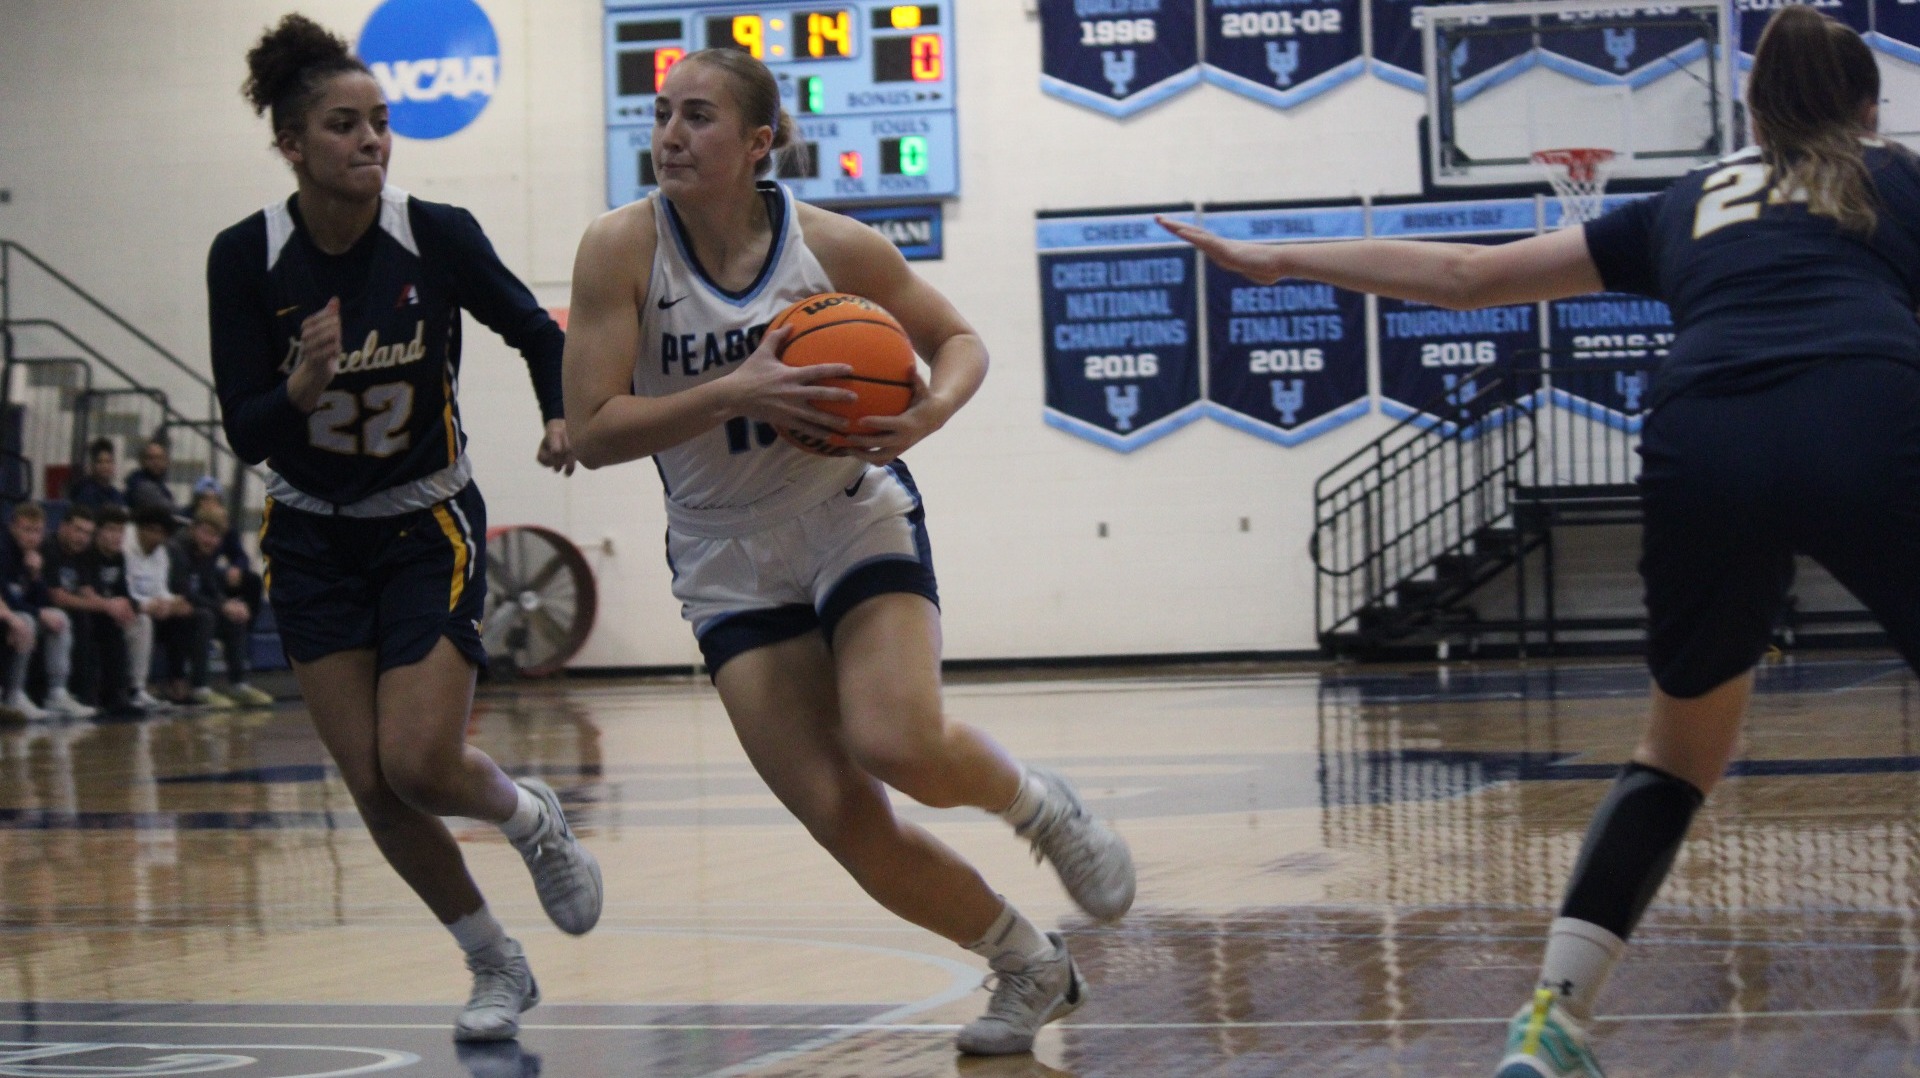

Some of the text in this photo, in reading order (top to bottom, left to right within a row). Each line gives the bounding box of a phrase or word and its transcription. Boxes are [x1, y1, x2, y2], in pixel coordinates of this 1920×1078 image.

[1080, 19, 1156, 46] 1996
[1221, 8, 1341, 38] 2001-02
[911, 33, 944, 82] 0
[369, 55, 496, 104] NCAA
[839, 150, 863, 179] 4
[900, 135, 929, 176] 0
[1081, 223, 1148, 241] CHEER
[1052, 257, 1185, 289] CHEER LIMITED
[1066, 289, 1173, 319] NATIONAL
[1230, 284, 1339, 313] REGIONAL
[1054, 319, 1188, 350] CHAMPIONS
[1229, 315, 1344, 344] FINALISTS
[1385, 306, 1532, 338] TOURNAMENT
[1084, 353, 1159, 380] 2016
[1250, 348, 1325, 373] 2016
[1421, 341, 1497, 367] 2016
[307, 380, 415, 458] 22
